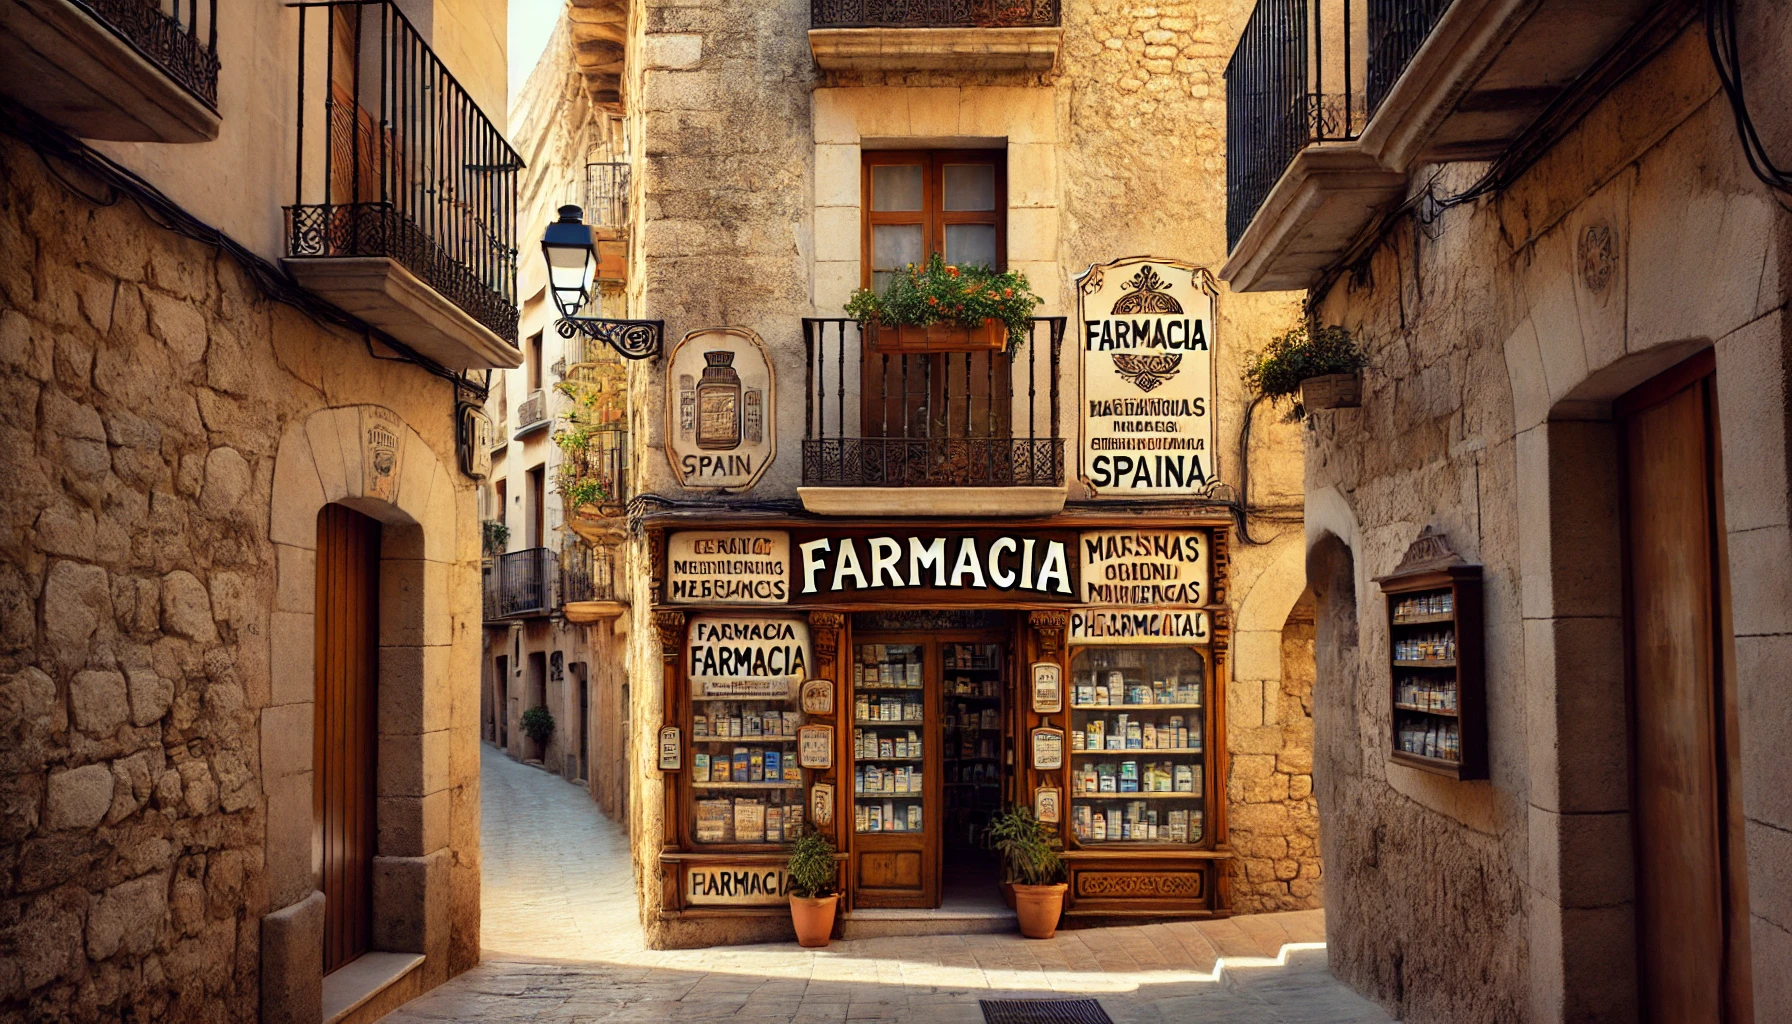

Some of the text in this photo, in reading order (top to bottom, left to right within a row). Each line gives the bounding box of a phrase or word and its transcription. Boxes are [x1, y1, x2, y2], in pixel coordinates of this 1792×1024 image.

[1085, 319, 1208, 351] FARMACIA
[682, 454, 751, 477] SPAIN
[1091, 455, 1206, 488] SPAINA
[799, 537, 1073, 594] FARMACIA
[698, 624, 795, 641] FARMACIA
[691, 645, 807, 680] FARMACIA
